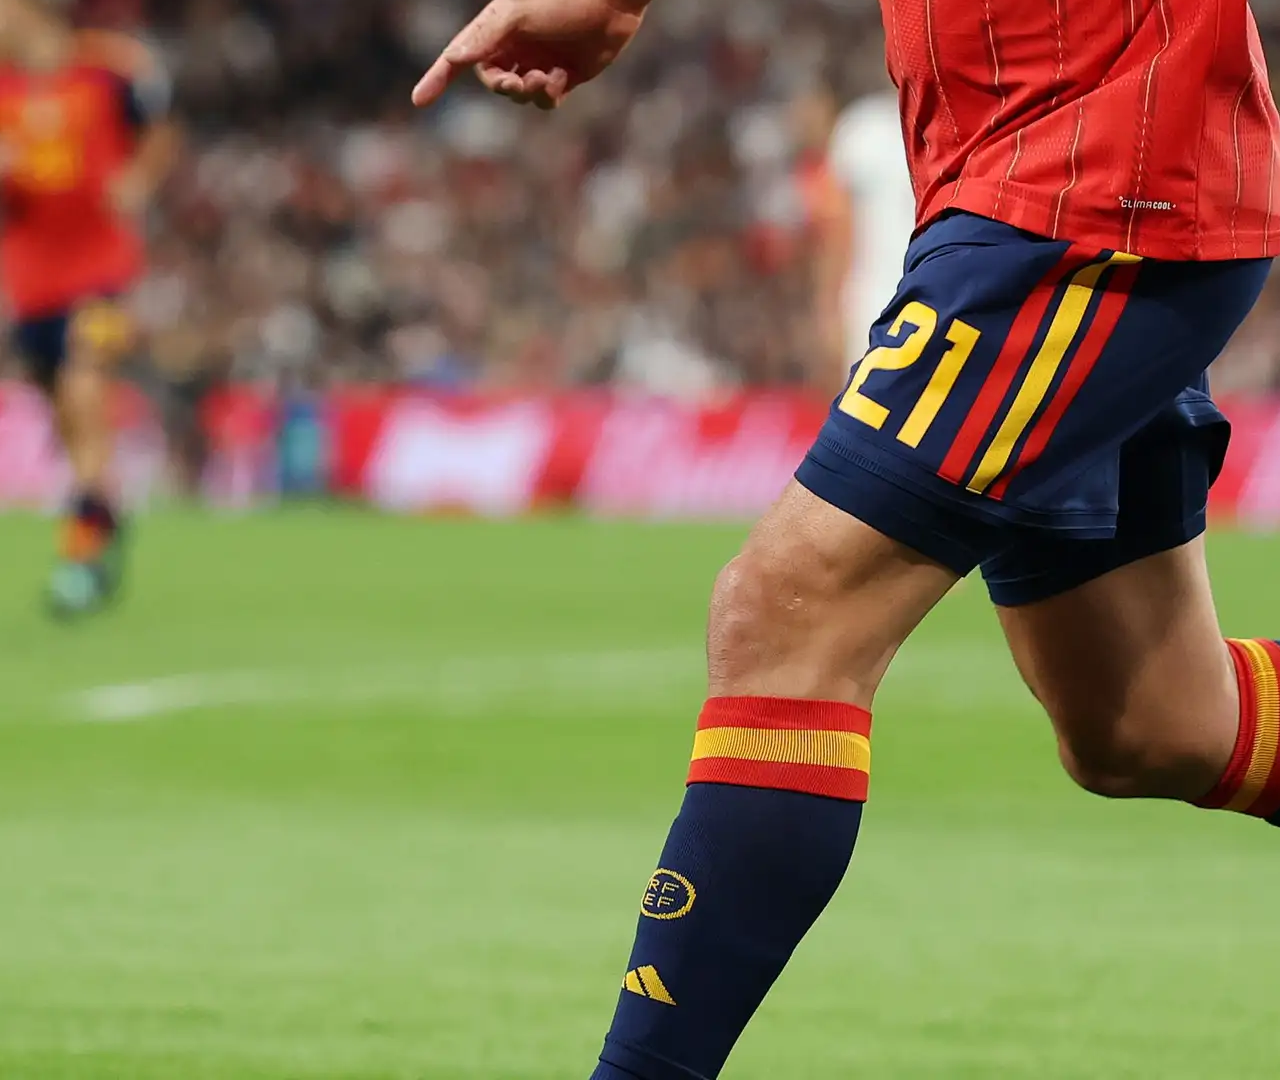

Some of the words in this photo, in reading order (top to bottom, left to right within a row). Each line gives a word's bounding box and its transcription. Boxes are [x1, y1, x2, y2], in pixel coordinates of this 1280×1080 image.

[1120, 199, 1172, 210] CLIMACOOL
[838, 300, 982, 449] 21
[648, 878, 680, 894] RF
[643, 892, 675, 908] EF
